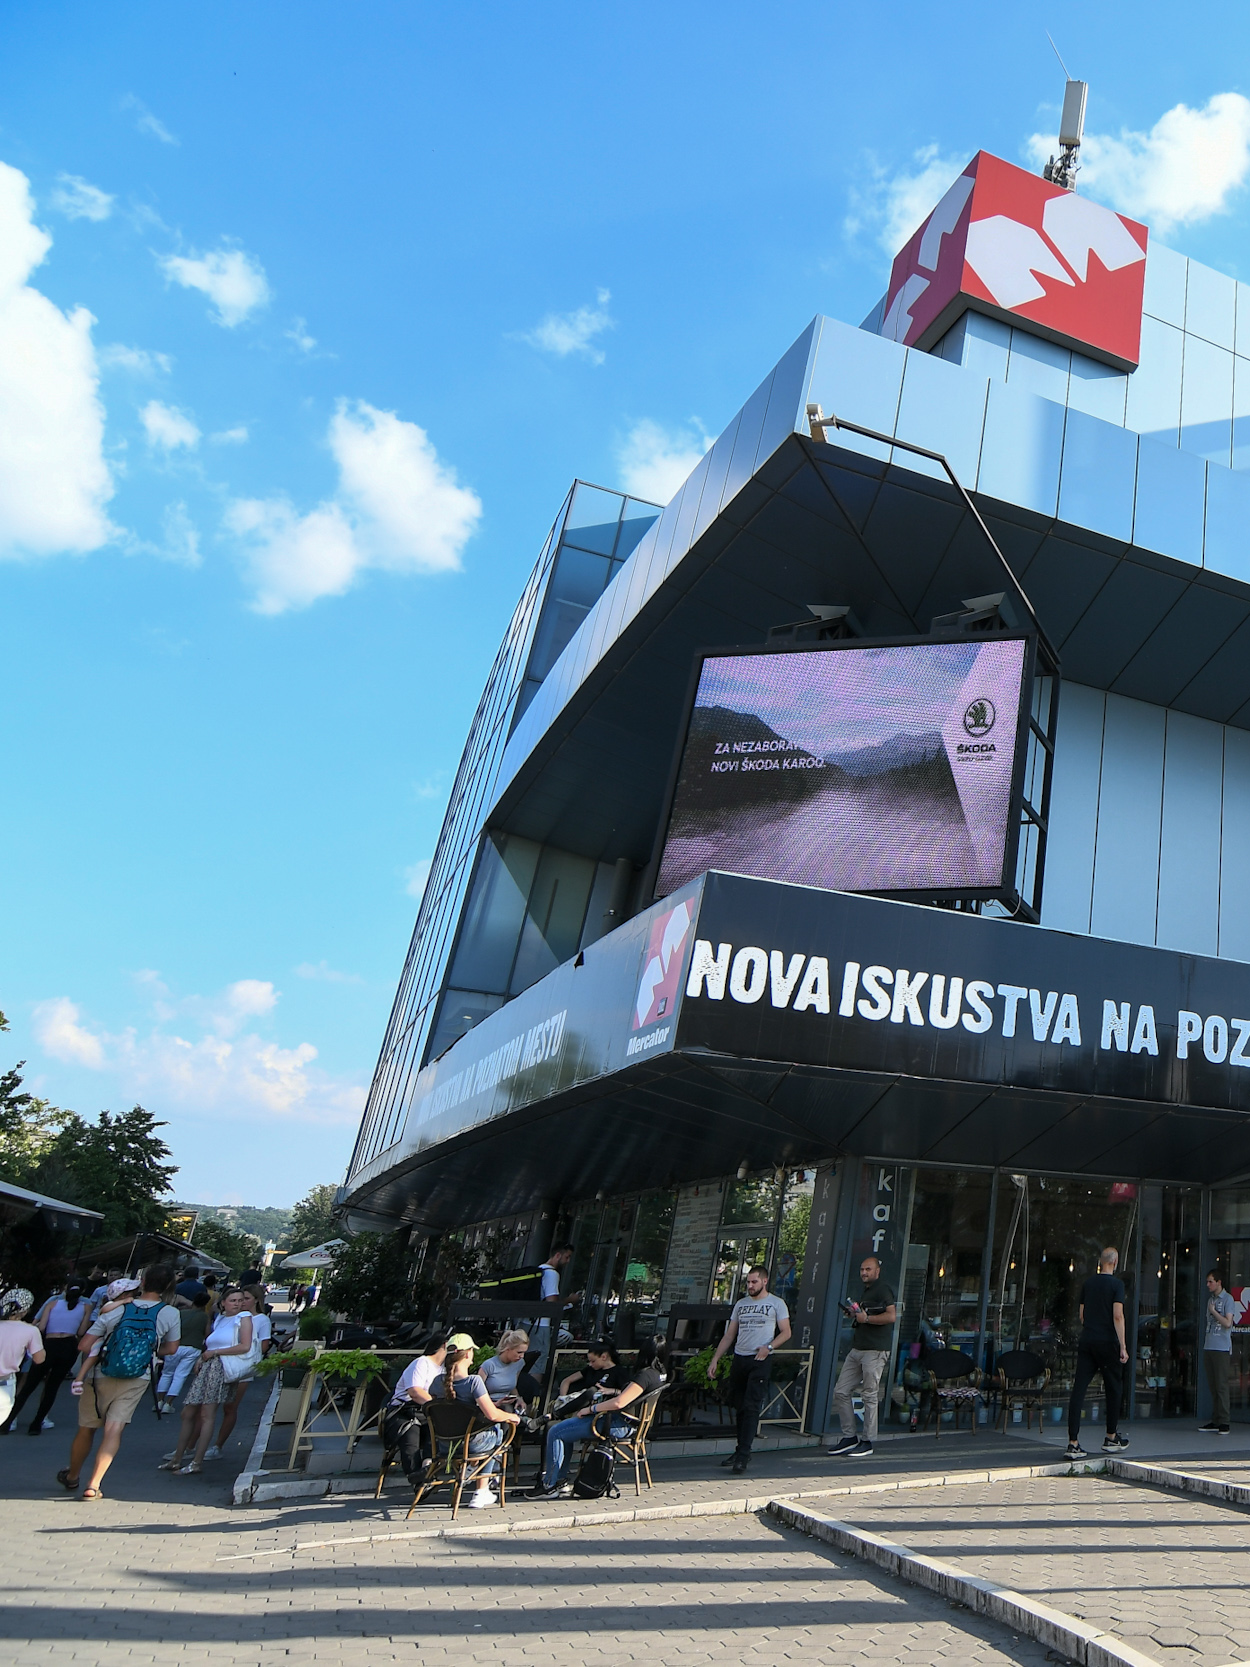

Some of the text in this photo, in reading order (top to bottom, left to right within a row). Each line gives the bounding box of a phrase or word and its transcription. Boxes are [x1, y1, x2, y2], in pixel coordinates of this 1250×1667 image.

[714, 743, 730, 754] ZA
[957, 743, 996, 753] ŠKODA
[711, 761, 739, 772] NOVI
[741, 757, 779, 771] ŠKODA
[685, 939, 830, 1014] NOVA
[838, 961, 1081, 1046] ISKUSTVA
[1100, 999, 1159, 1056] NA
[520, 1009, 568, 1071] MESTU
[627, 1026, 670, 1056] Mercator
[872, 1168, 893, 1266] kaf
[738, 1304, 772, 1316] REPLAY
